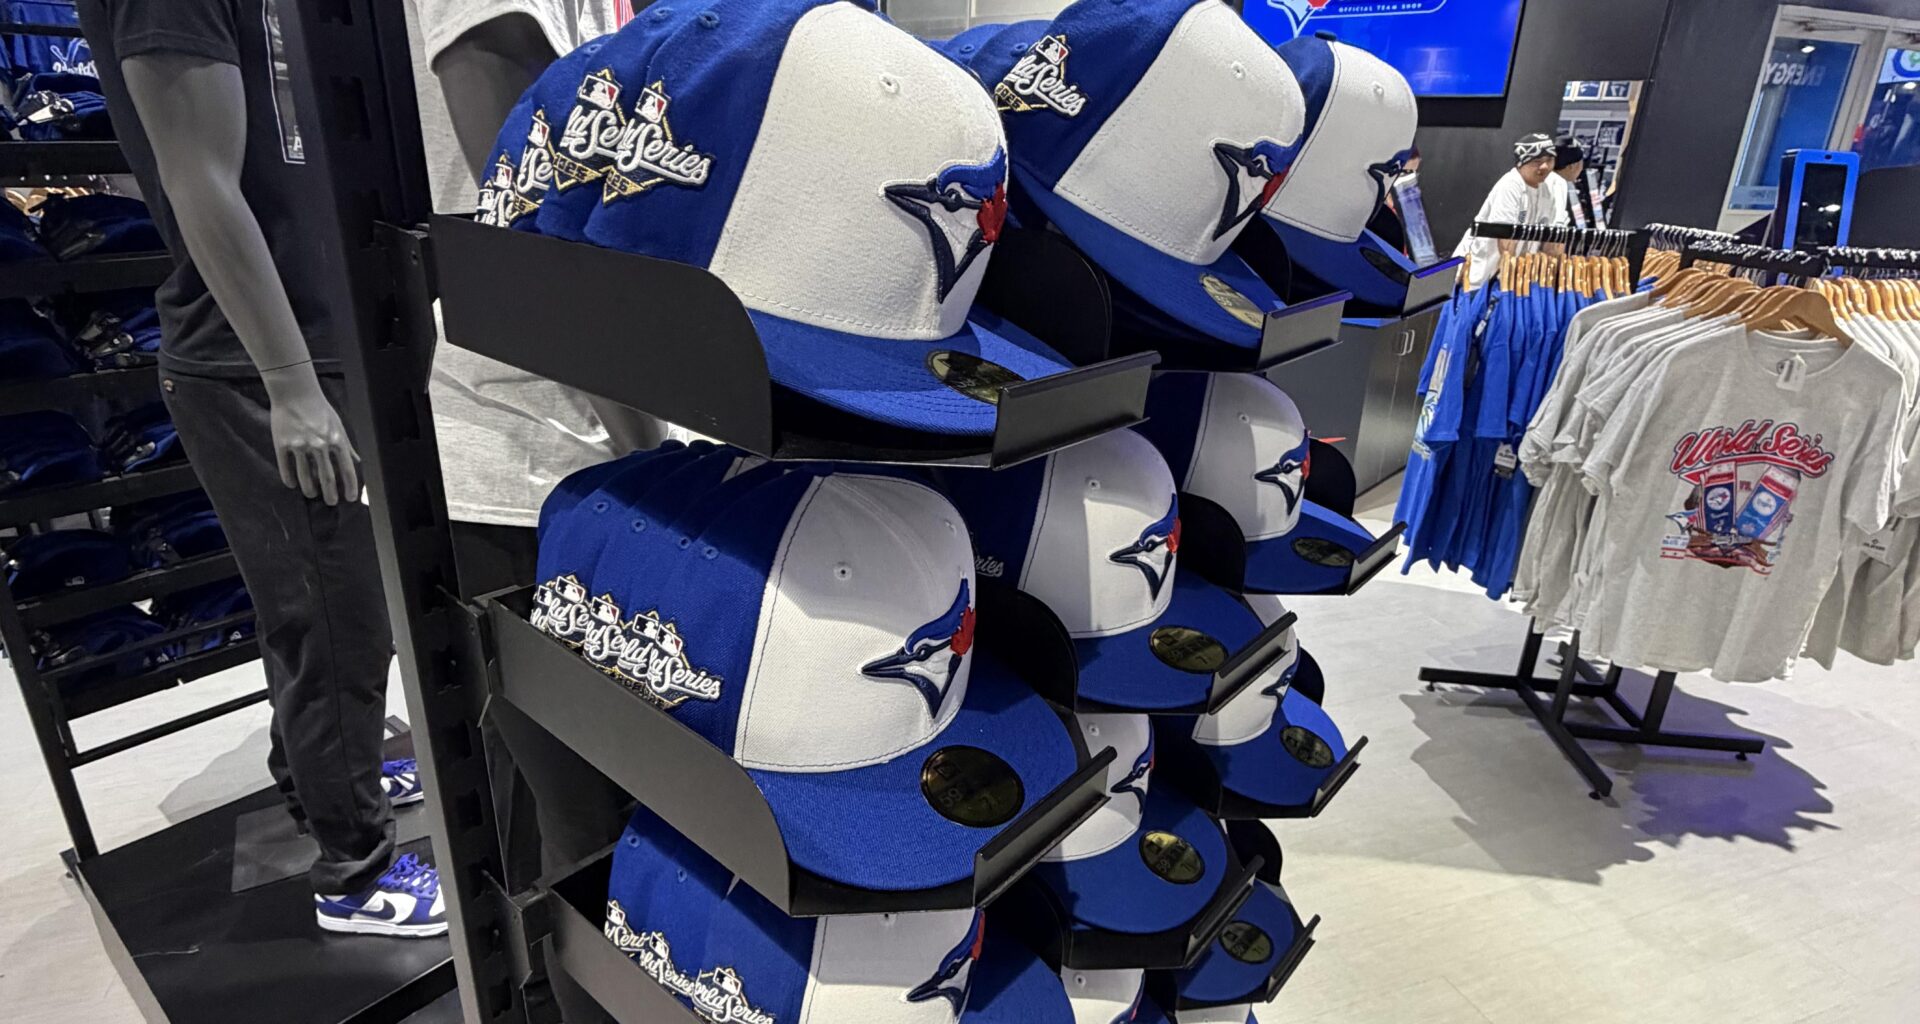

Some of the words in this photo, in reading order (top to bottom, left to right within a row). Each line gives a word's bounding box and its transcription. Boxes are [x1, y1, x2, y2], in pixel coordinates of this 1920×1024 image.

[1401, 2, 1422, 10] SHOP
[1014, 63, 1086, 117] Series
[617, 123, 711, 185] Series
[975, 555, 1004, 577] ries
[648, 654, 721, 699] Series
[614, 925, 650, 950] Seri
